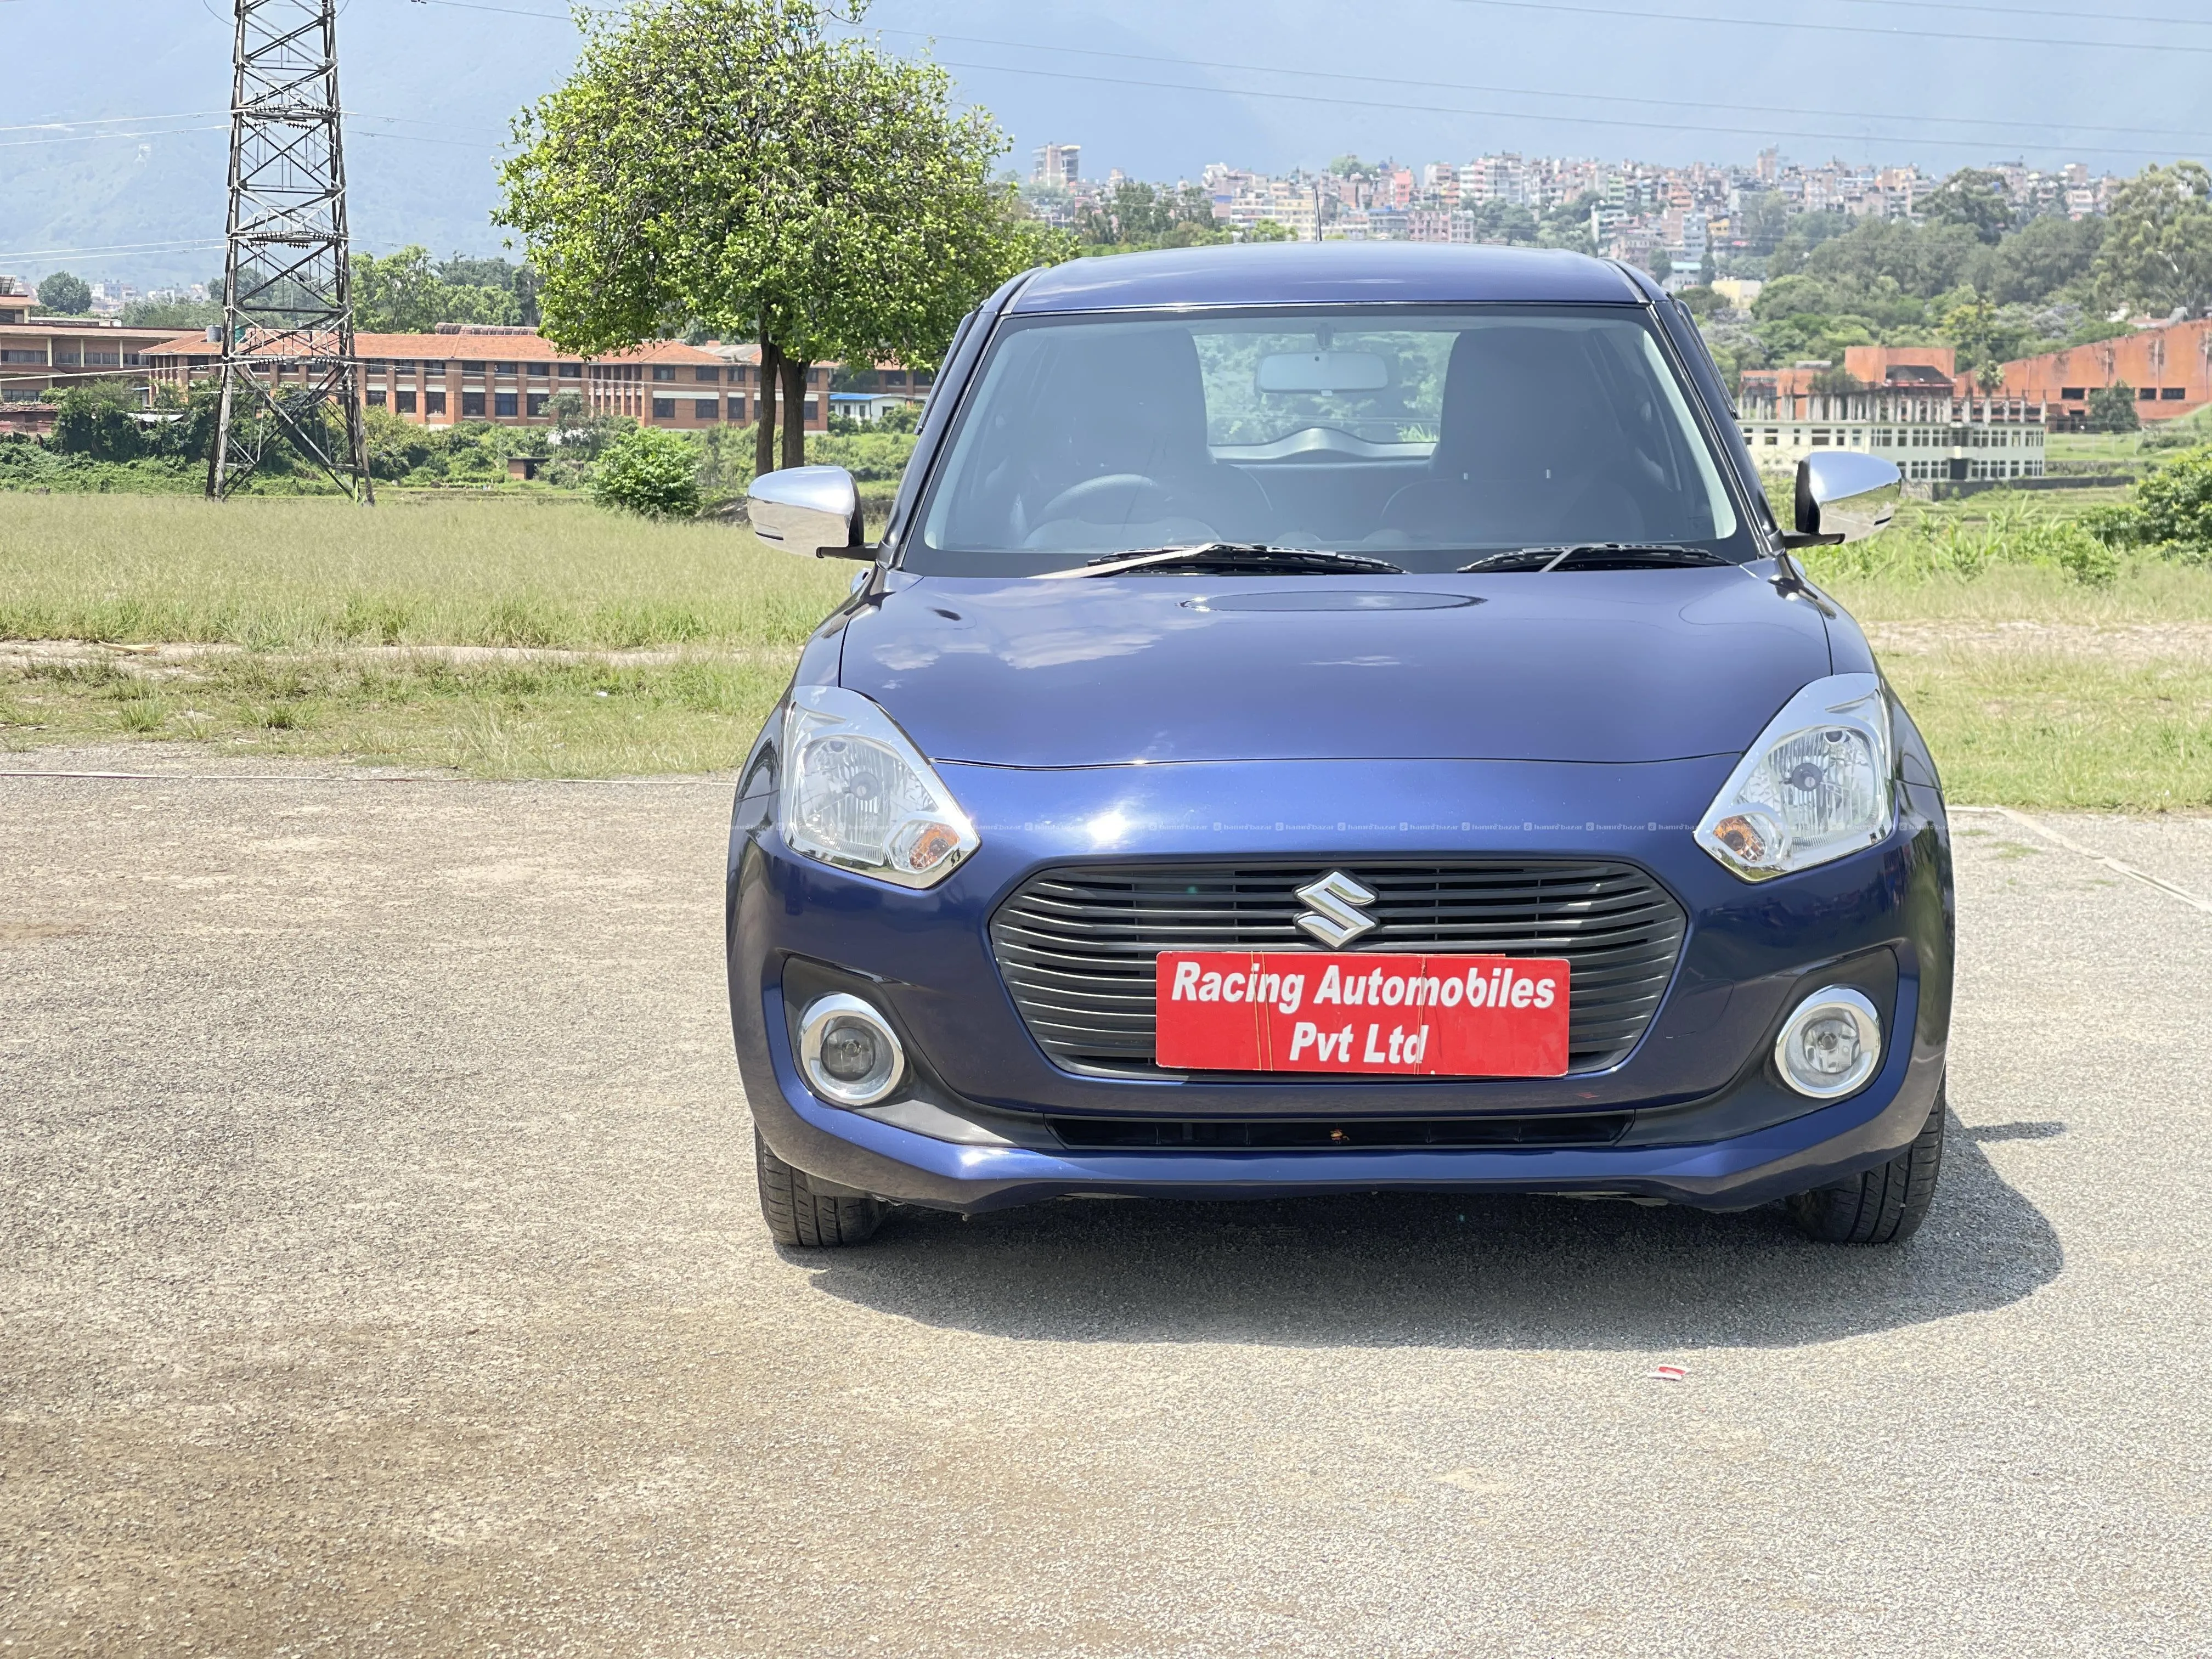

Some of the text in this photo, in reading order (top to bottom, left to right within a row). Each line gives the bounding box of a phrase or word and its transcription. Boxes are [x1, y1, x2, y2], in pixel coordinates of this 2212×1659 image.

[1172, 961, 1556, 1014] Racing Automobiles
[1289, 1022, 1429, 1064] Pvt Ltd
